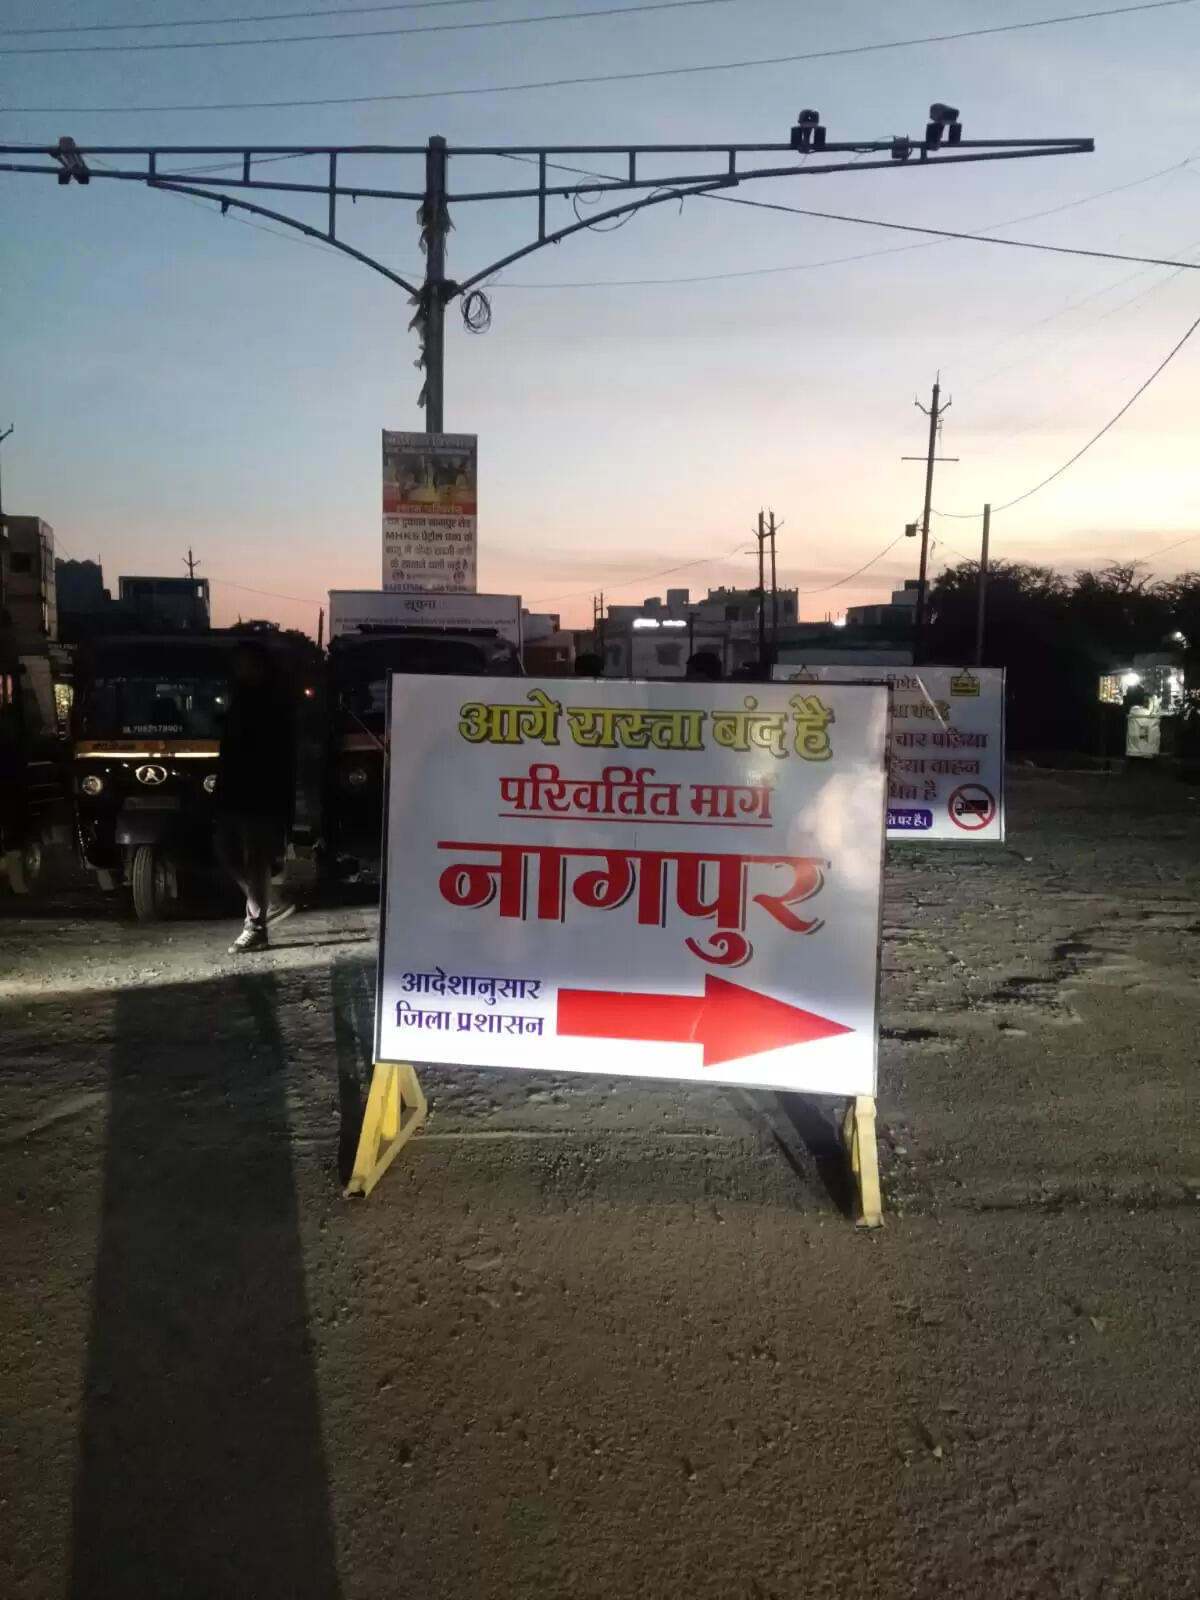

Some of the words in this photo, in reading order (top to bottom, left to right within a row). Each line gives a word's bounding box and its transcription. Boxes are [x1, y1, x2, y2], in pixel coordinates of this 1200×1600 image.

[457, 687, 564, 750] आगे
[566, 704, 706, 753] रास्ता
[712, 695, 788, 758] बंद
[788, 694, 834, 762] है
[498, 762, 682, 818] परिवर्तित
[437, 840, 832, 967] नागपुर
[401, 965, 543, 1006] आदेशानुसार
[395, 999, 452, 1031] जिला
[456, 1011, 545, 1037] प्रशासन
